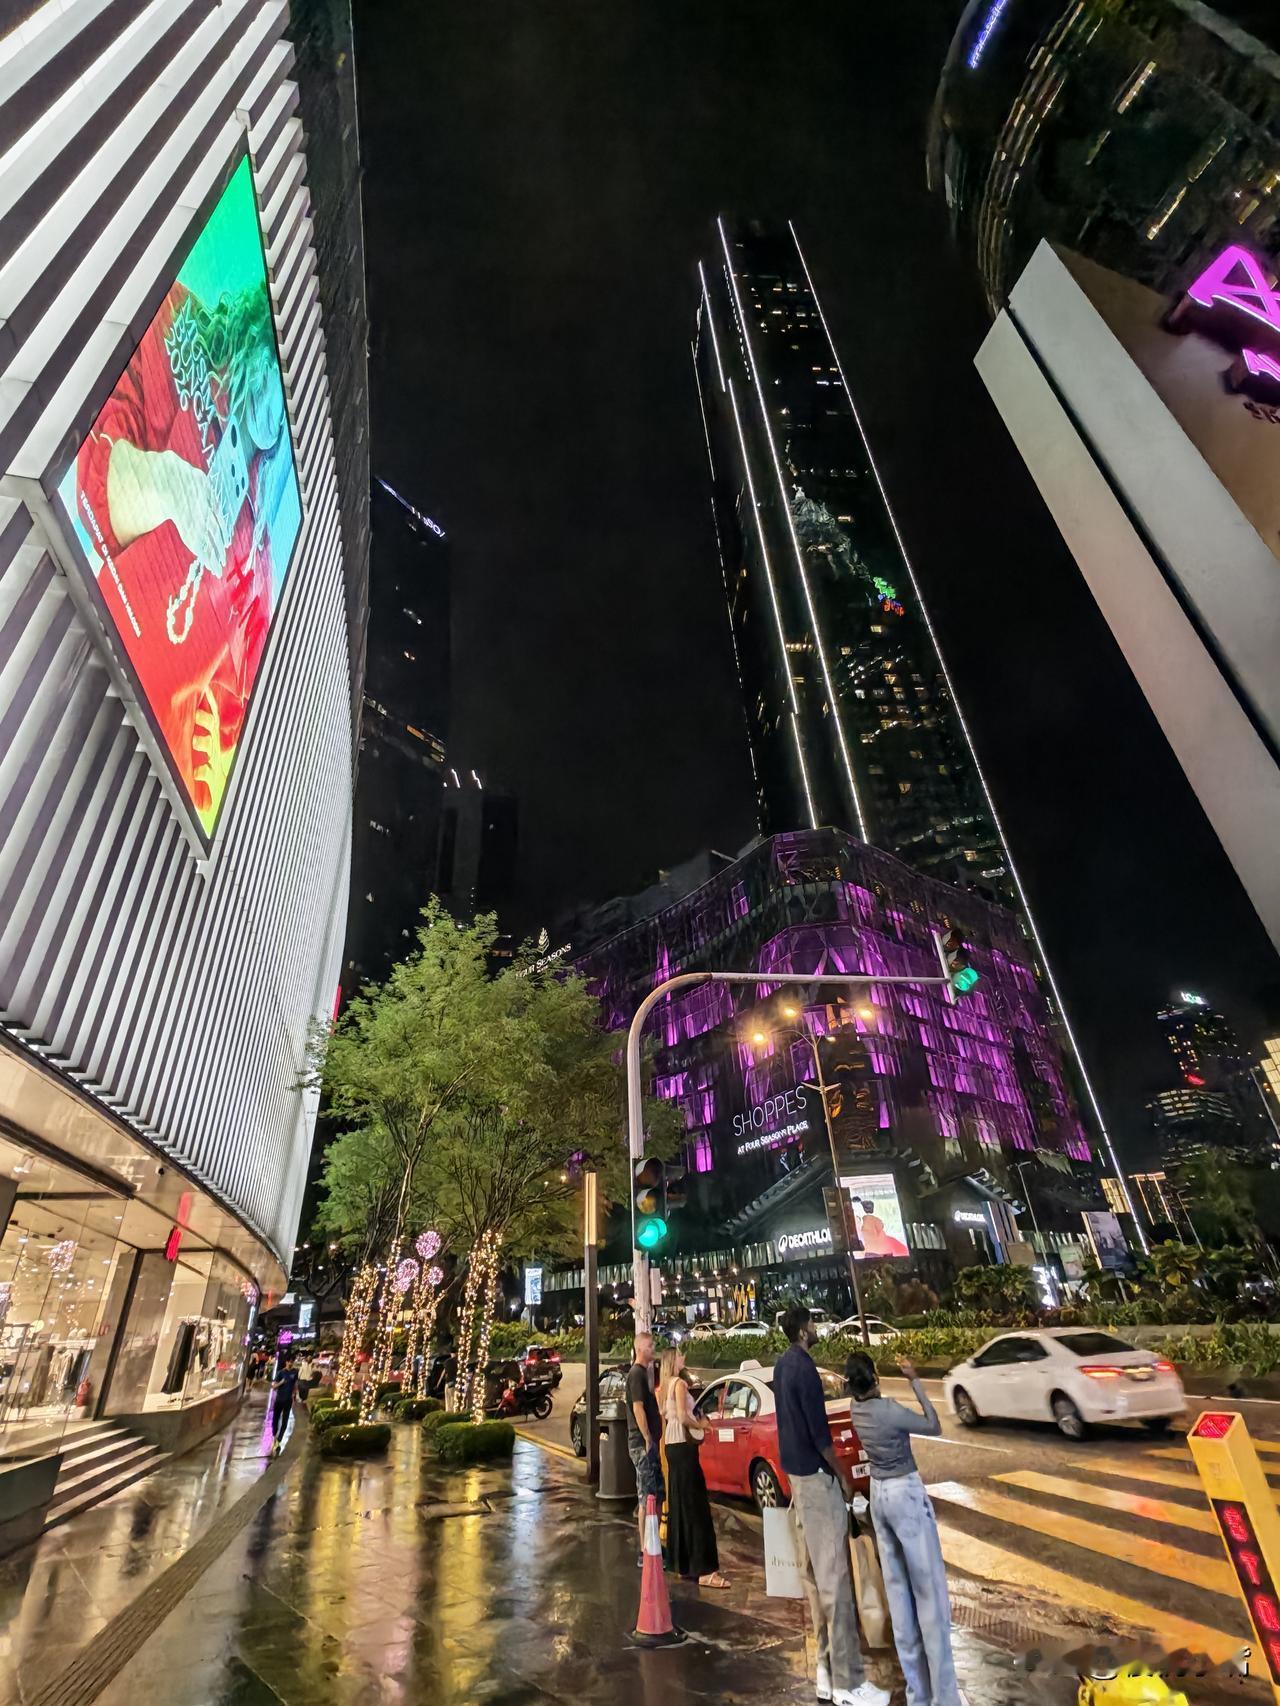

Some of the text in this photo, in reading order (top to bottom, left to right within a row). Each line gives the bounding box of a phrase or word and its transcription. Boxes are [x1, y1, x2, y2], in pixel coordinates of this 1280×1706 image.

[163, 327, 191, 412] 2026
[179, 293, 217, 425] MUSIM
[80, 489, 104, 544] TERDAPAT
[536, 942, 572, 969] SEASONS
[732, 1085, 808, 1137] SHOPPES
[786, 1120, 810, 1136] PLACE
